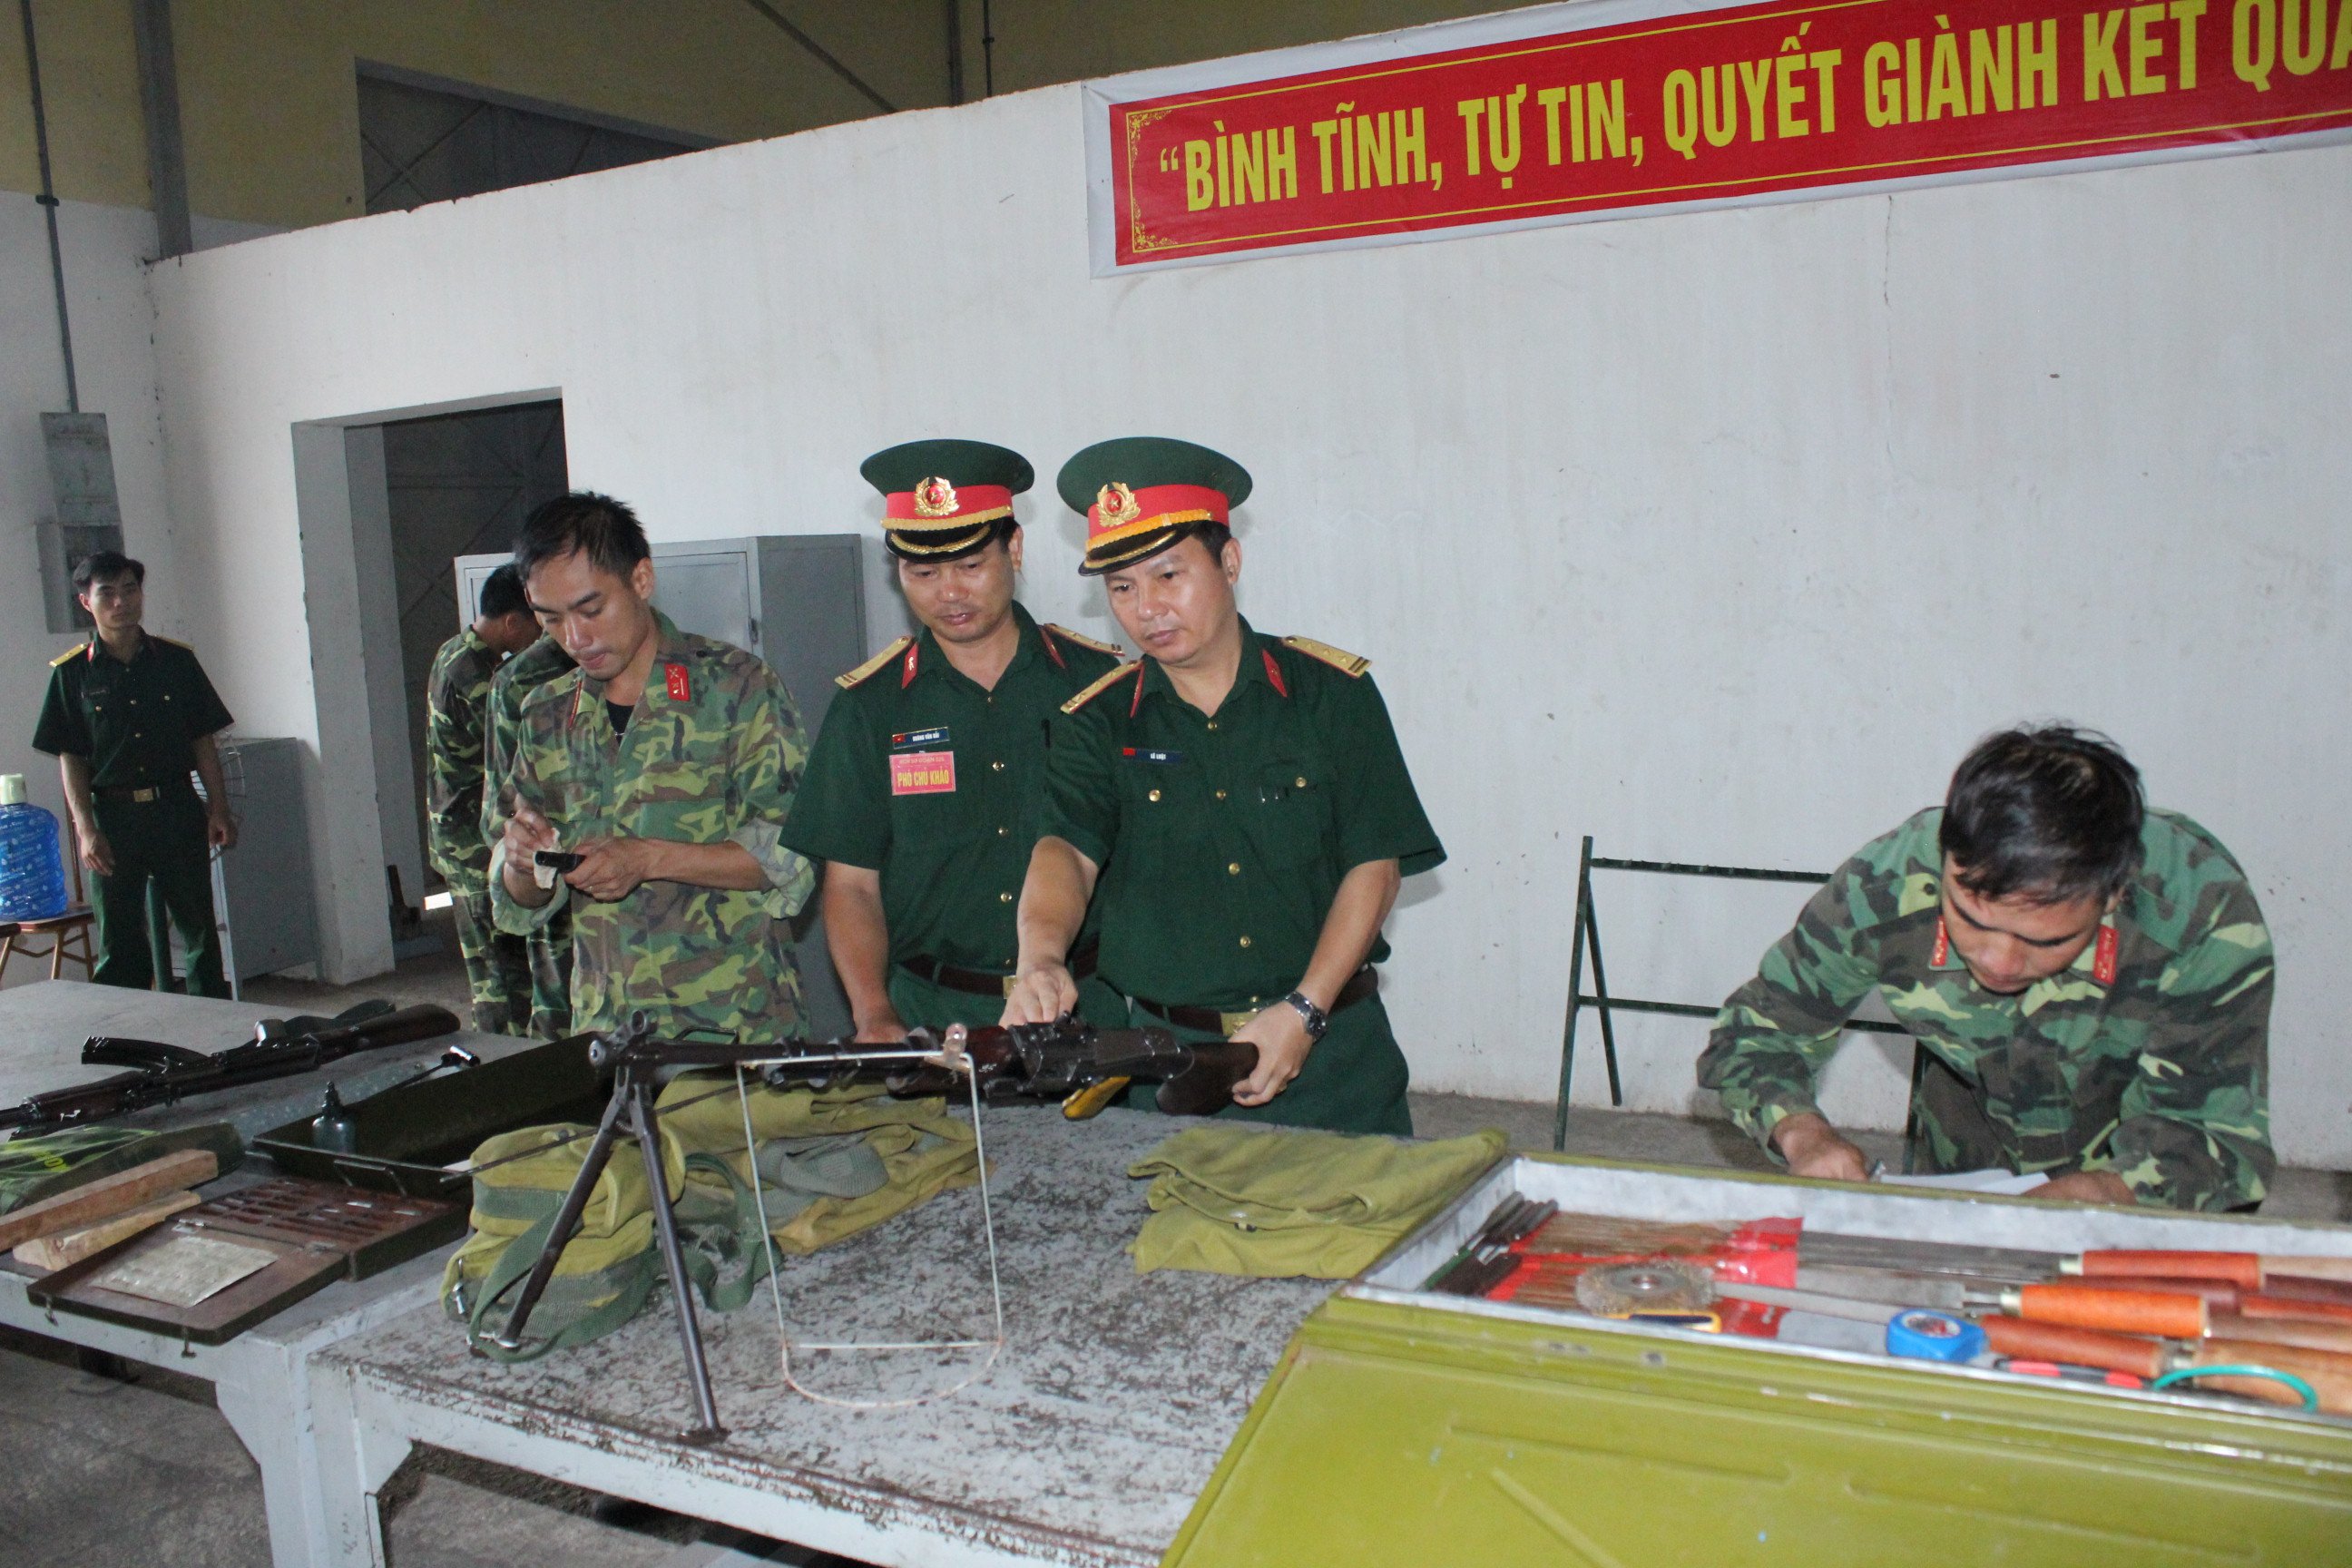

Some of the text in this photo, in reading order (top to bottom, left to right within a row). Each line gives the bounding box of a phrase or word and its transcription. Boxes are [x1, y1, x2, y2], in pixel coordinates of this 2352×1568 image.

[1312, 100, 1442, 194] TĨNH,
[1458, 83, 1526, 189] TỰ
[1537, 78, 1643, 167] TIN,
[1662, 21, 1842, 161] QUYẾT
[1863, 15, 2059, 129] GIÀNH
